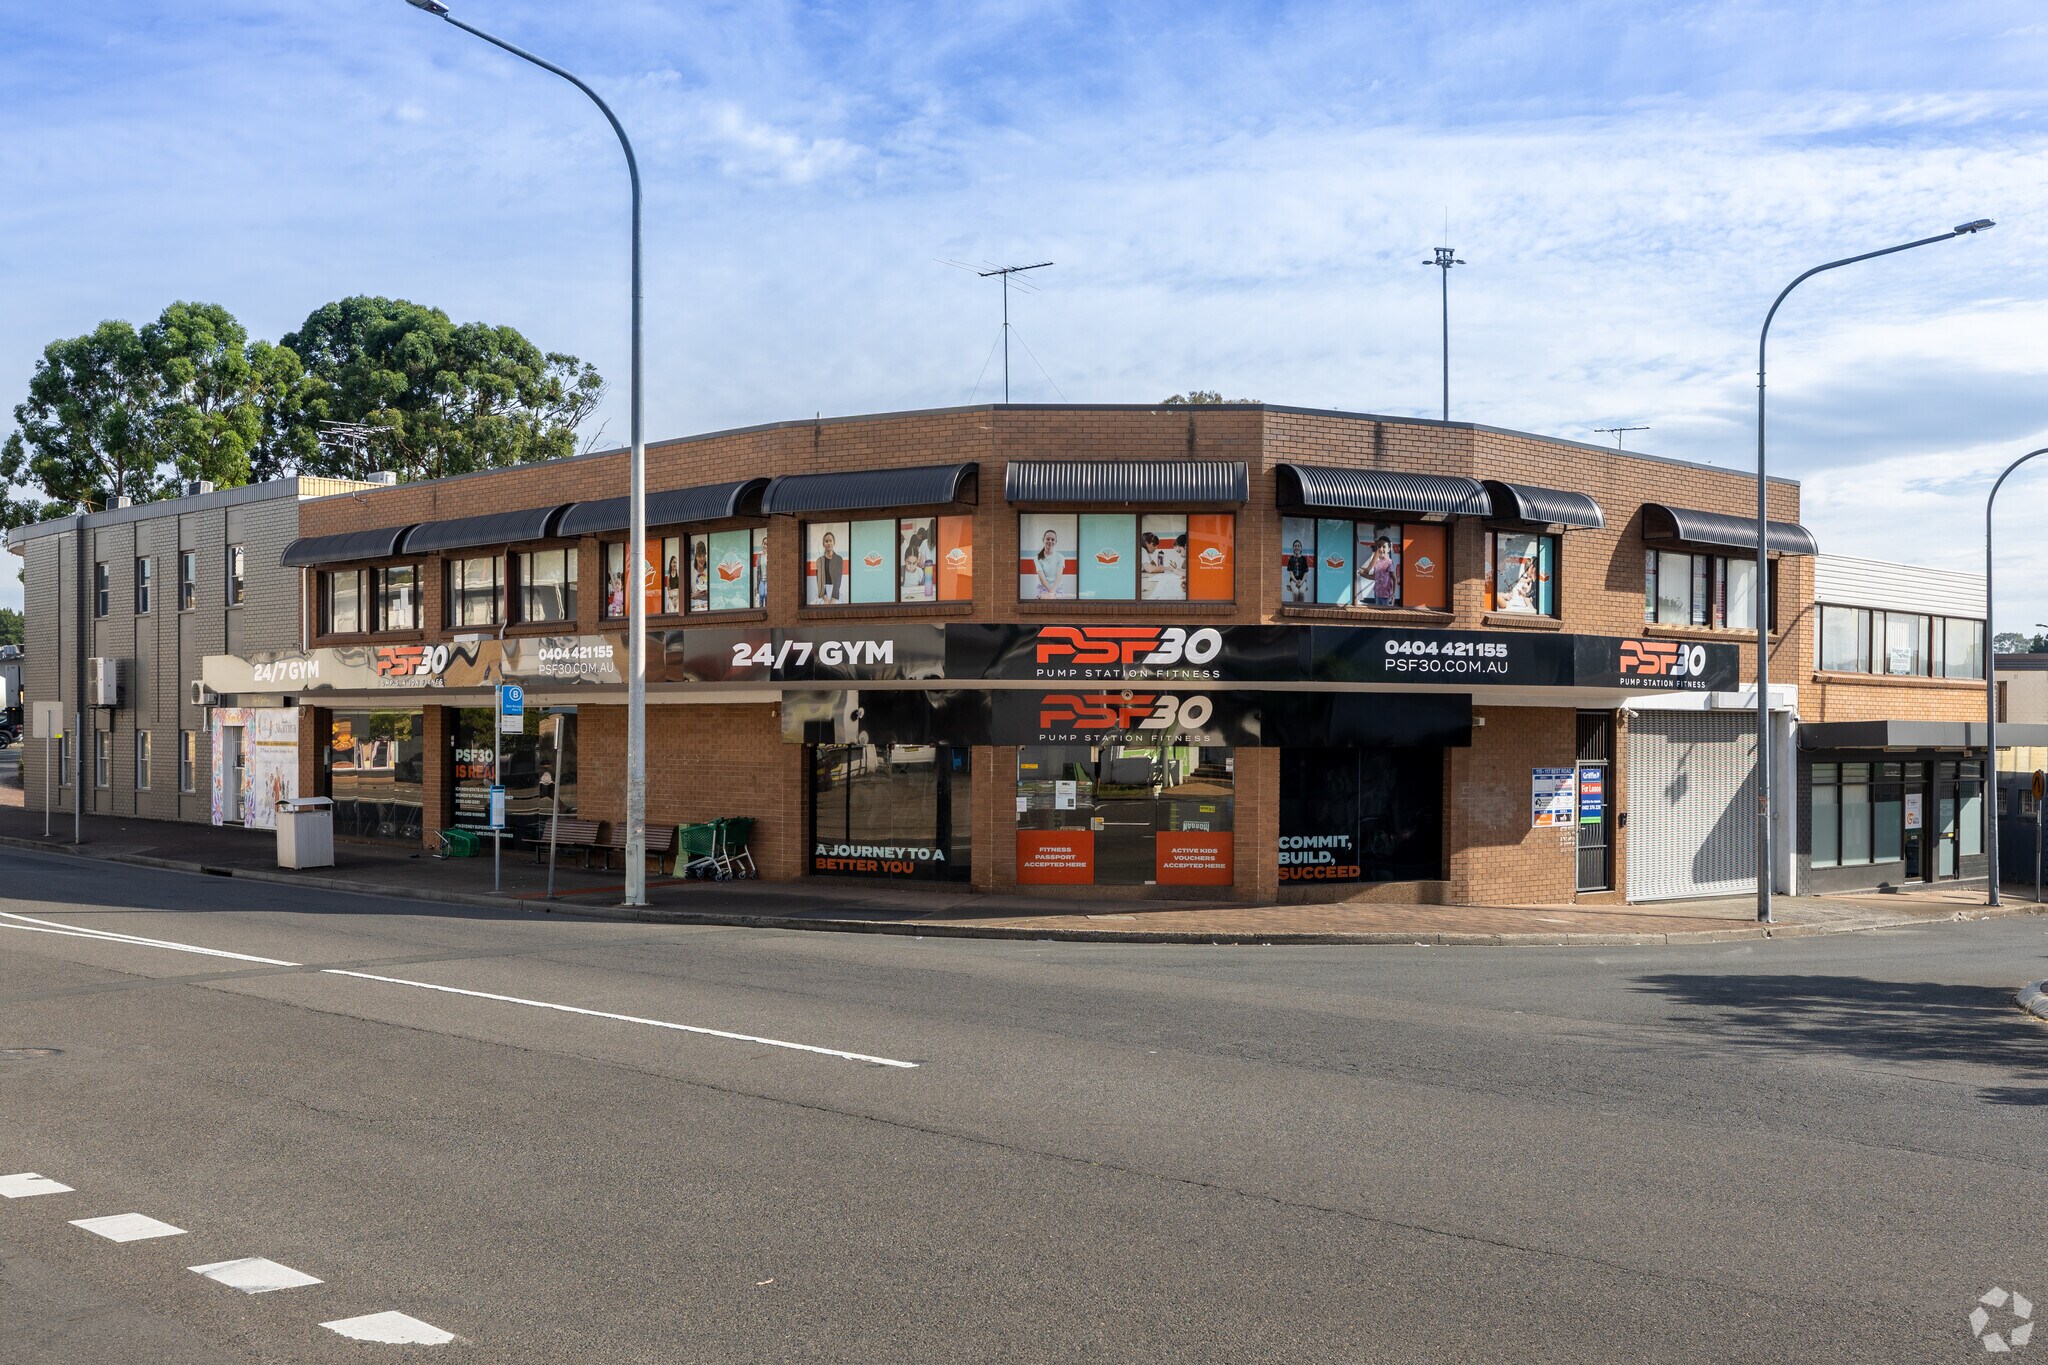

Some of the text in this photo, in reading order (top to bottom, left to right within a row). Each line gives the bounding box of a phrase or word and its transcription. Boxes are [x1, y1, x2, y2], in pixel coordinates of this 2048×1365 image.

[1037, 626, 1222, 665] PSF30
[1385, 640, 1439, 655] 0404
[377, 645, 449, 676] PSF30
[539, 647, 570, 660] 0404
[732, 640, 894, 670] 24/7 GYM
[1620, 640, 1706, 676] PSF30
[254, 660, 320, 683] 24/7 GYM
[538, 662, 614, 675] PSF30.COM.AU
[1036, 669, 1220, 678] PUMP STATION FITNESS
[1385, 659, 1508, 673] PSF30.COM.AU
[1620, 677, 1706, 688] PUMP STATION FITNESS
[1040, 694, 1213, 729] PSF30
[455, 748, 494, 762] PSF30
[455, 764, 467, 778] IS
[1589, 784, 1602, 792] Lease
[1278, 835, 1352, 850] COMMIT,
[815, 844, 945, 861] A JOURNEY TO A
[1278, 851, 1336, 866] BUILD,
[816, 858, 914, 874] BETTER YOU
[1278, 865, 1361, 880] SUCCEED
